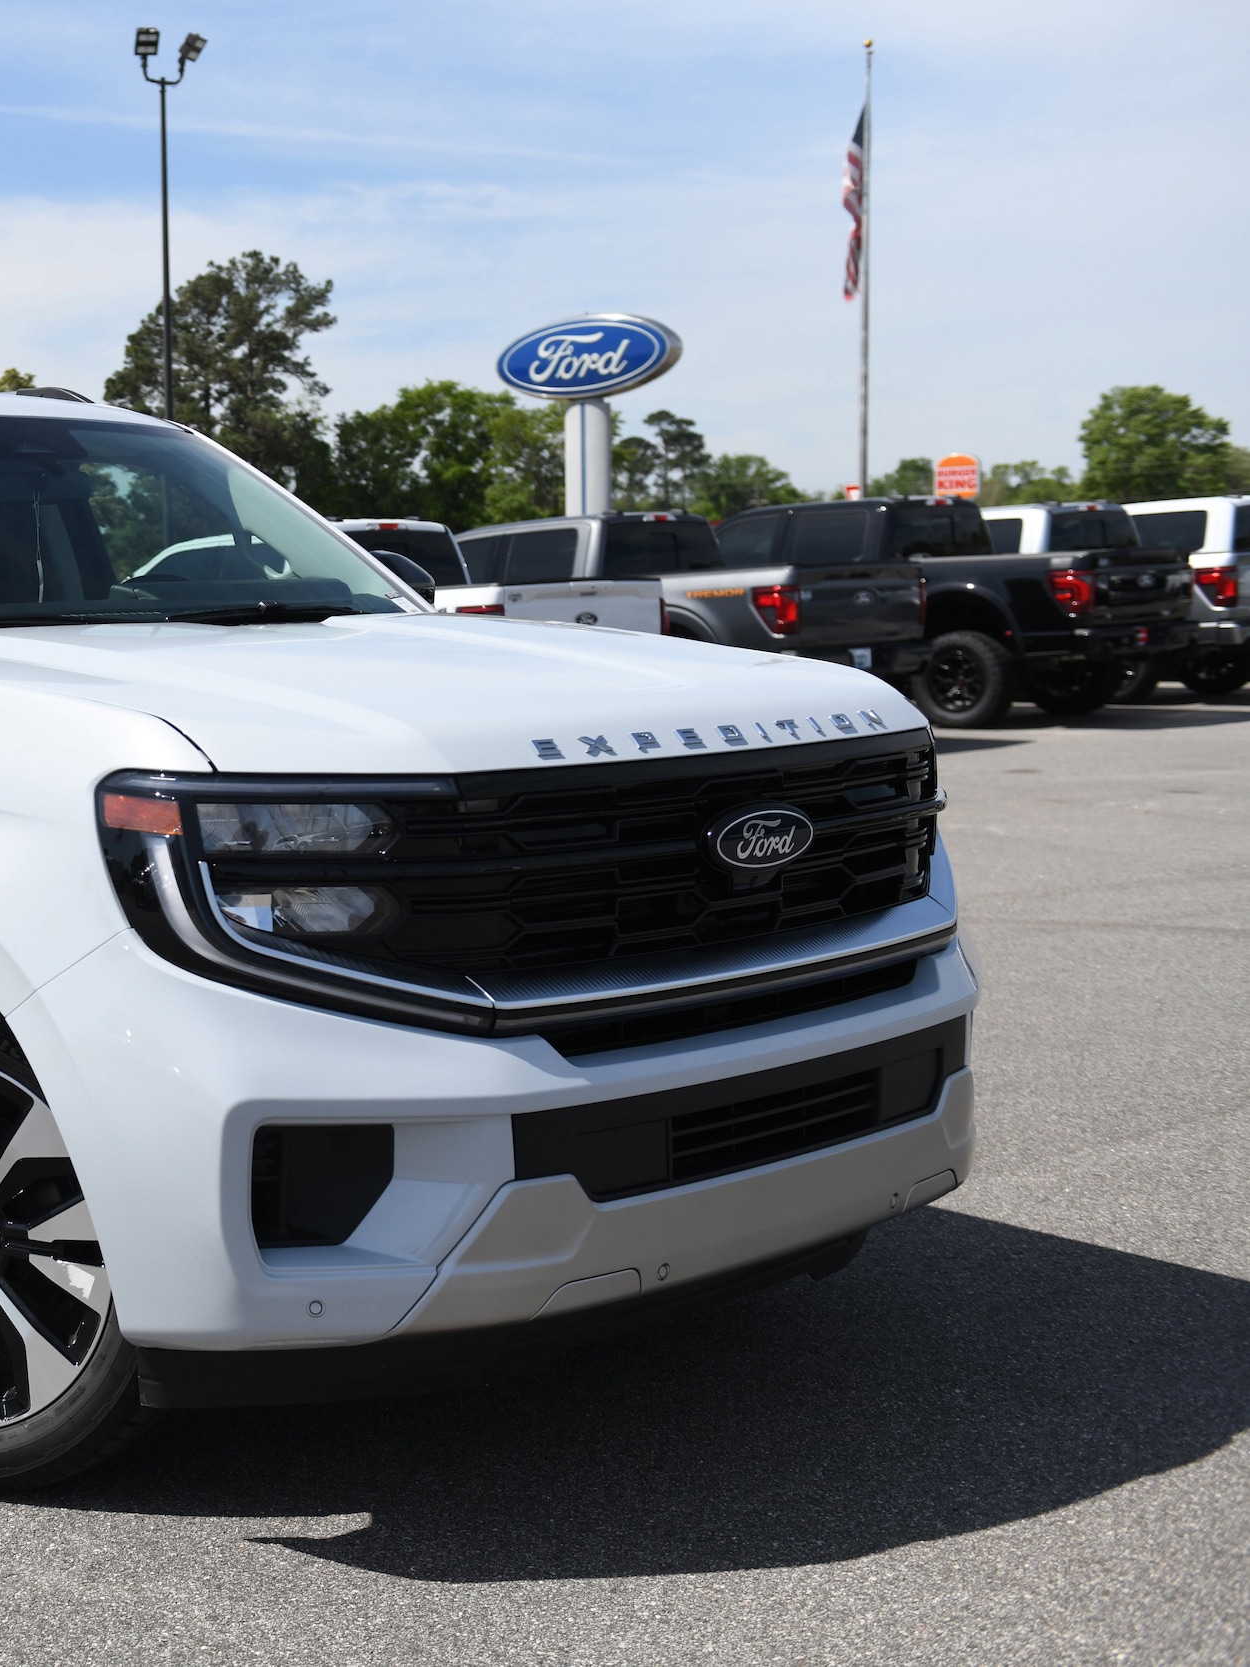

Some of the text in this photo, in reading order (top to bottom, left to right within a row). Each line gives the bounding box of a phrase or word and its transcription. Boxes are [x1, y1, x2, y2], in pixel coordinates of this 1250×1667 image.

[528, 331, 631, 384] Ford
[937, 478, 976, 490] KING
[685, 587, 745, 600] TREMOR
[529, 708, 888, 758] EXPEDITION
[736, 818, 796, 860] Ford
